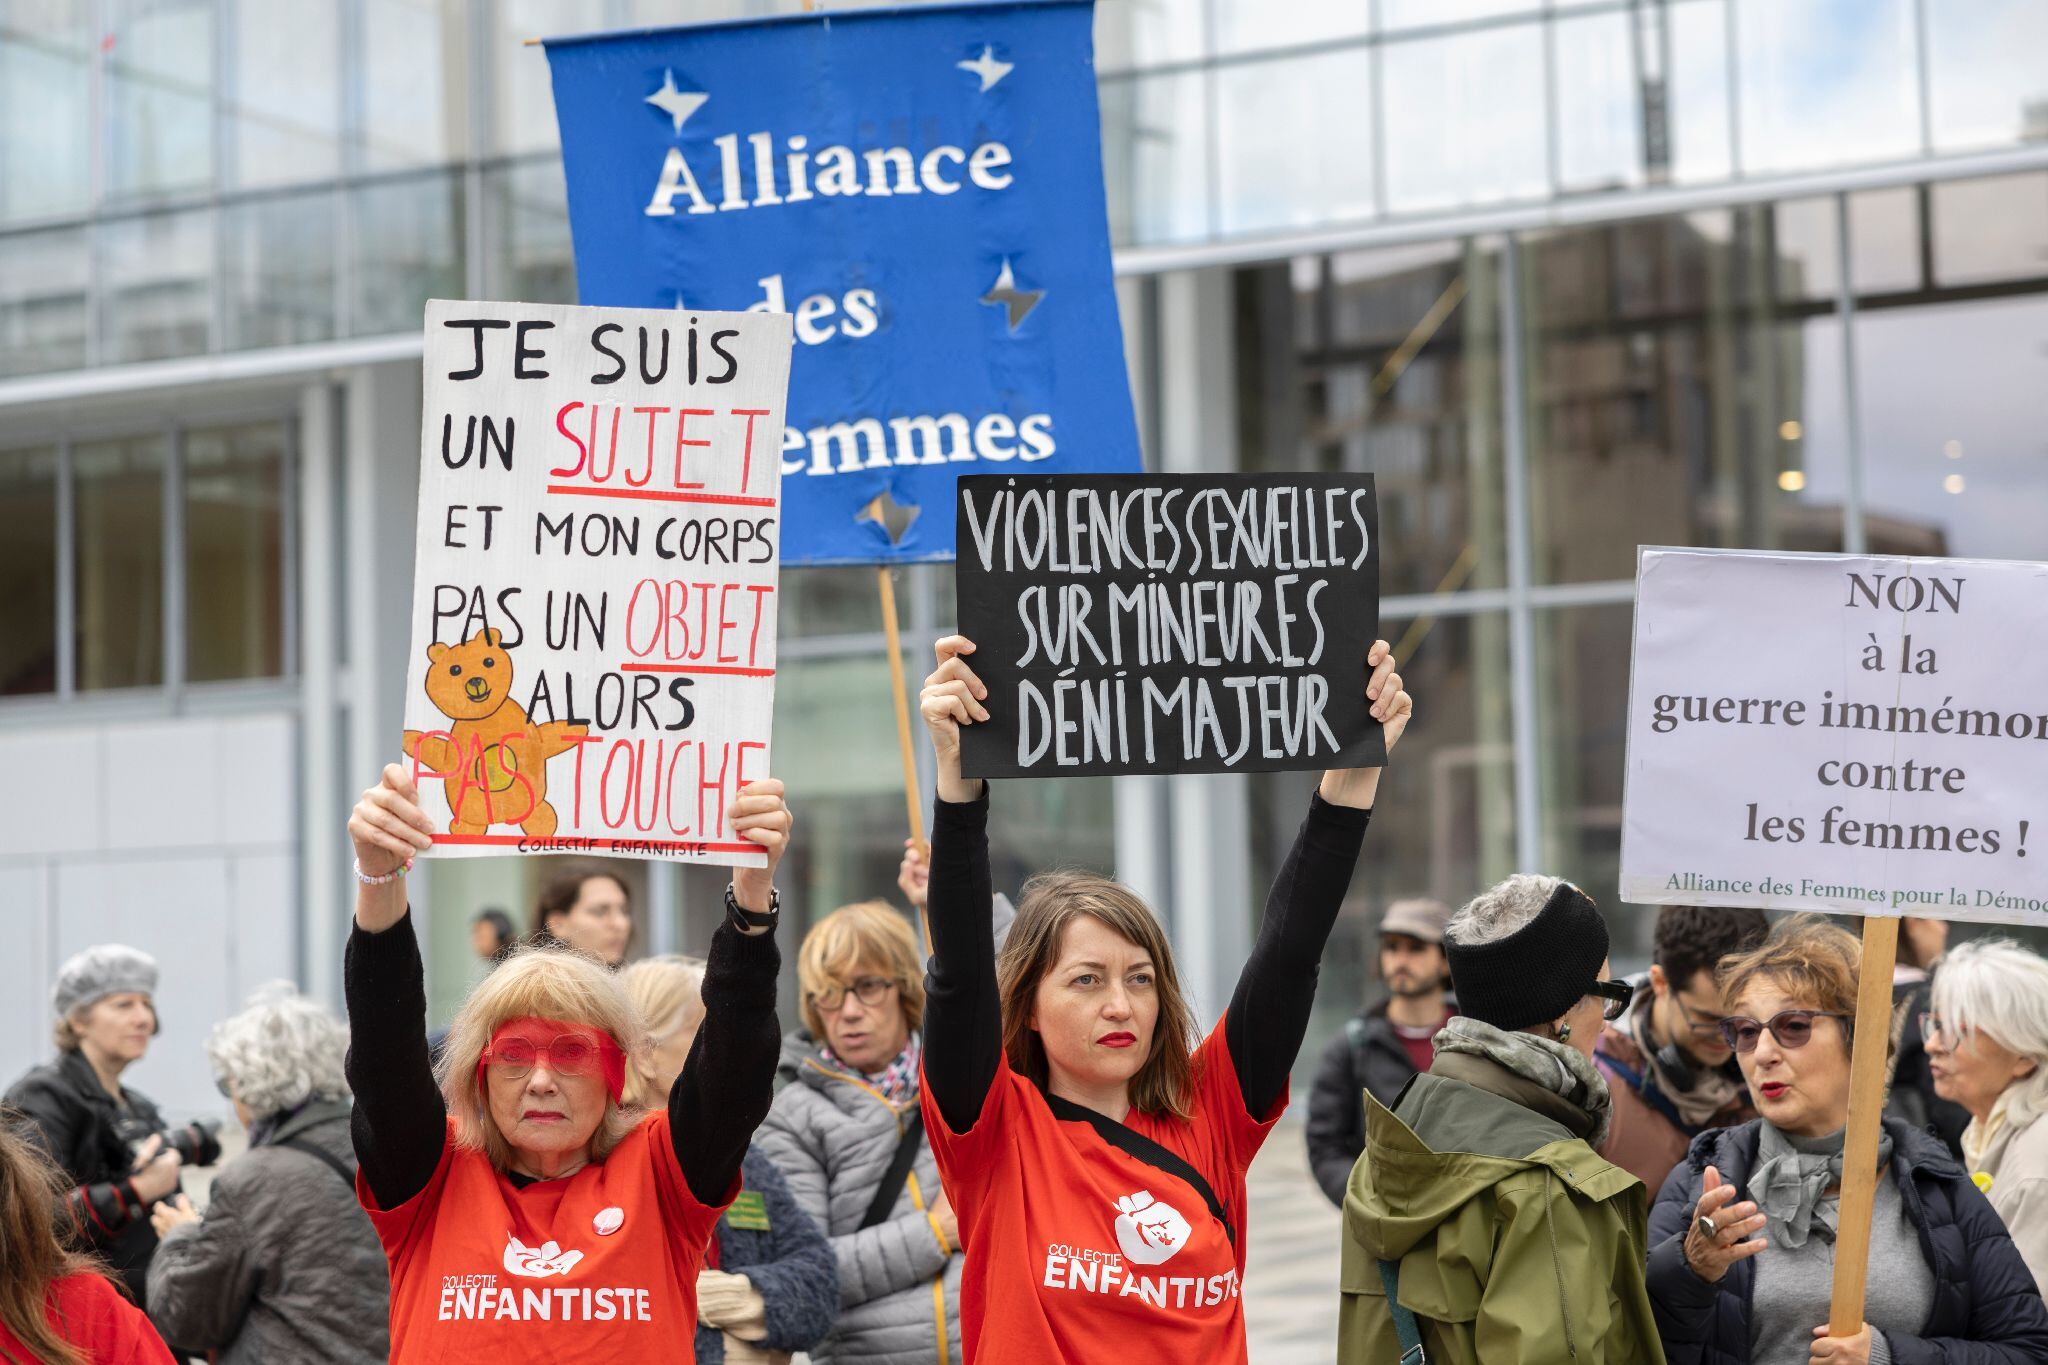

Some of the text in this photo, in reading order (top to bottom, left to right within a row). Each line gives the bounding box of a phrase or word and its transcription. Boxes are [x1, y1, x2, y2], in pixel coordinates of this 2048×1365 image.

[645, 131, 1013, 215] Alliance
[444, 320, 555, 380] JE
[442, 401, 772, 494] UN SUJET
[445, 505, 774, 564] ET MON CORPS
[1186, 487, 1370, 576] SEXUELLES
[432, 579, 775, 666] PAS UN OBJET
[1845, 573, 1966, 613] NON
[1016, 583, 1108, 667] SUR
[1862, 633, 1938, 674] à la
[526, 669, 696, 731] ALORS
[1141, 673, 1341, 767] MAJEUR
[1652, 695, 1805, 733] guerre
[413, 730, 536, 826] PAS
[1818, 760, 1965, 793] contre
[1744, 803, 2029, 857] les femmes !
[1666, 873, 1752, 893] Alliance
[1759, 877, 1792, 895] des
[1801, 880, 1885, 902] Femmes
[1891, 888, 1945, 910] pour
[1950, 888, 1966, 905] la
[443, 1274, 498, 1289] COLLECTIF
[1048, 1243, 1122, 1267] COLLECTIF
[439, 1287, 652, 1322] ENFANTISTE
